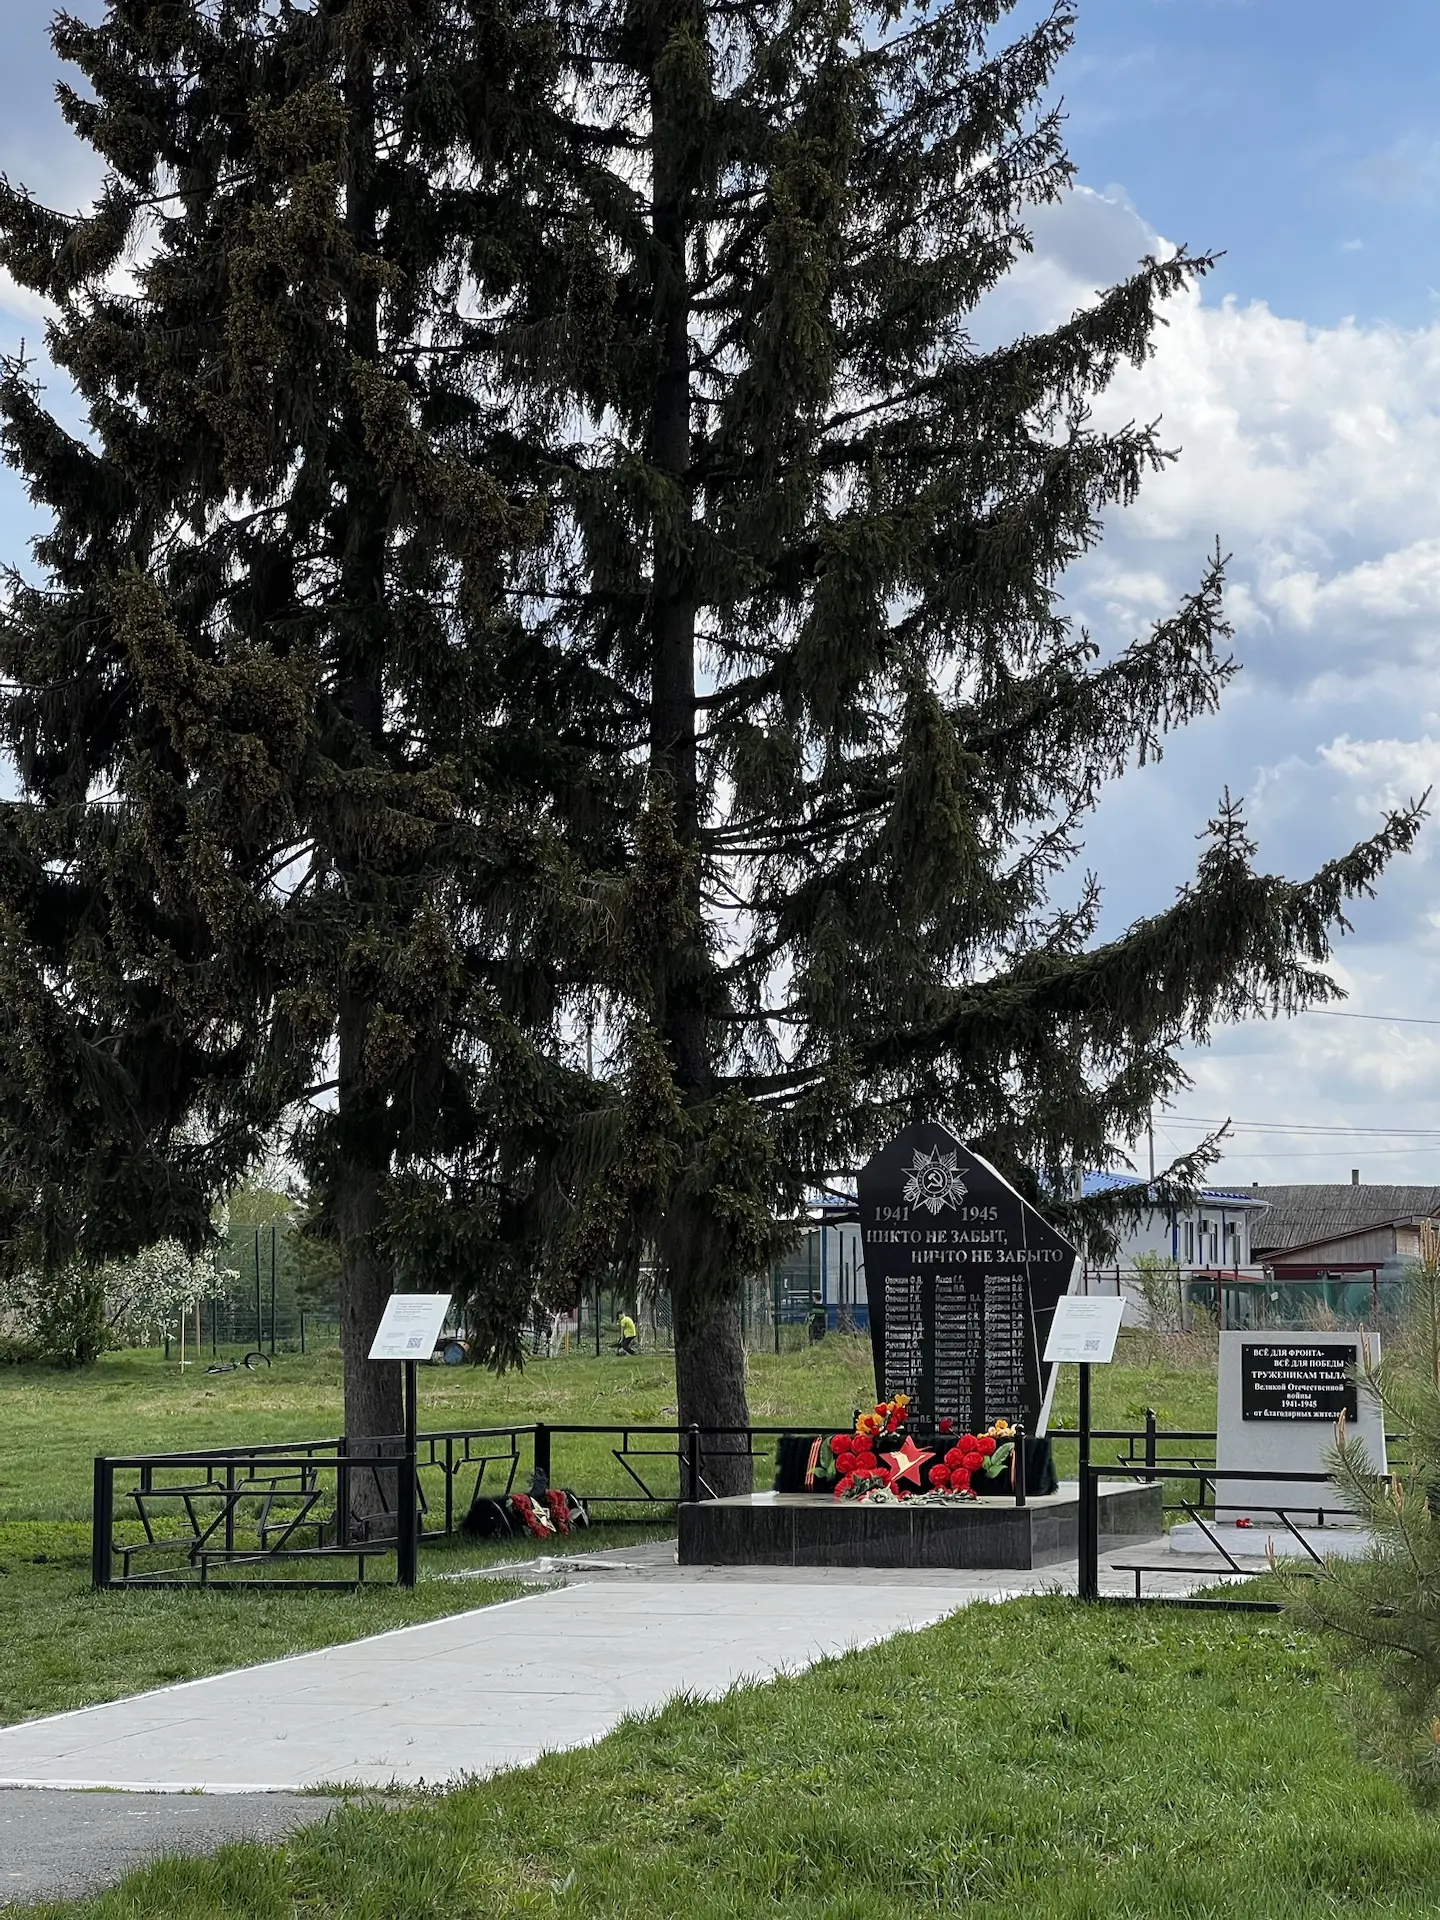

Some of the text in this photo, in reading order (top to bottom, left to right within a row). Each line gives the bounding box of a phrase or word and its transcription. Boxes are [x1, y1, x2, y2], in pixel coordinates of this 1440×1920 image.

[874, 1206, 998, 1221] 1941 1945
[866, 1229, 1008, 1245] НИКТО НЕ ЗАБЫТ,
[911, 1249, 1064, 1264] НИЧТО НЕ ЗАБЫТО
[1253, 1348, 1269, 1357] ВСЁ
[1270, 1349, 1287, 1357] ДЛЯ
[1274, 1358, 1344, 1368] ВСЁ ДЛЯ ПОБЕДЫ
[1251, 1371, 1346, 1380] ТРУЖЕНИКАМ ТЫЛА
[1254, 1382, 1344, 1391] Великой Отечественной
[1281, 1400, 1317, 1408] 1941-1945
[1263, 1408, 1312, 1419] благодарных
